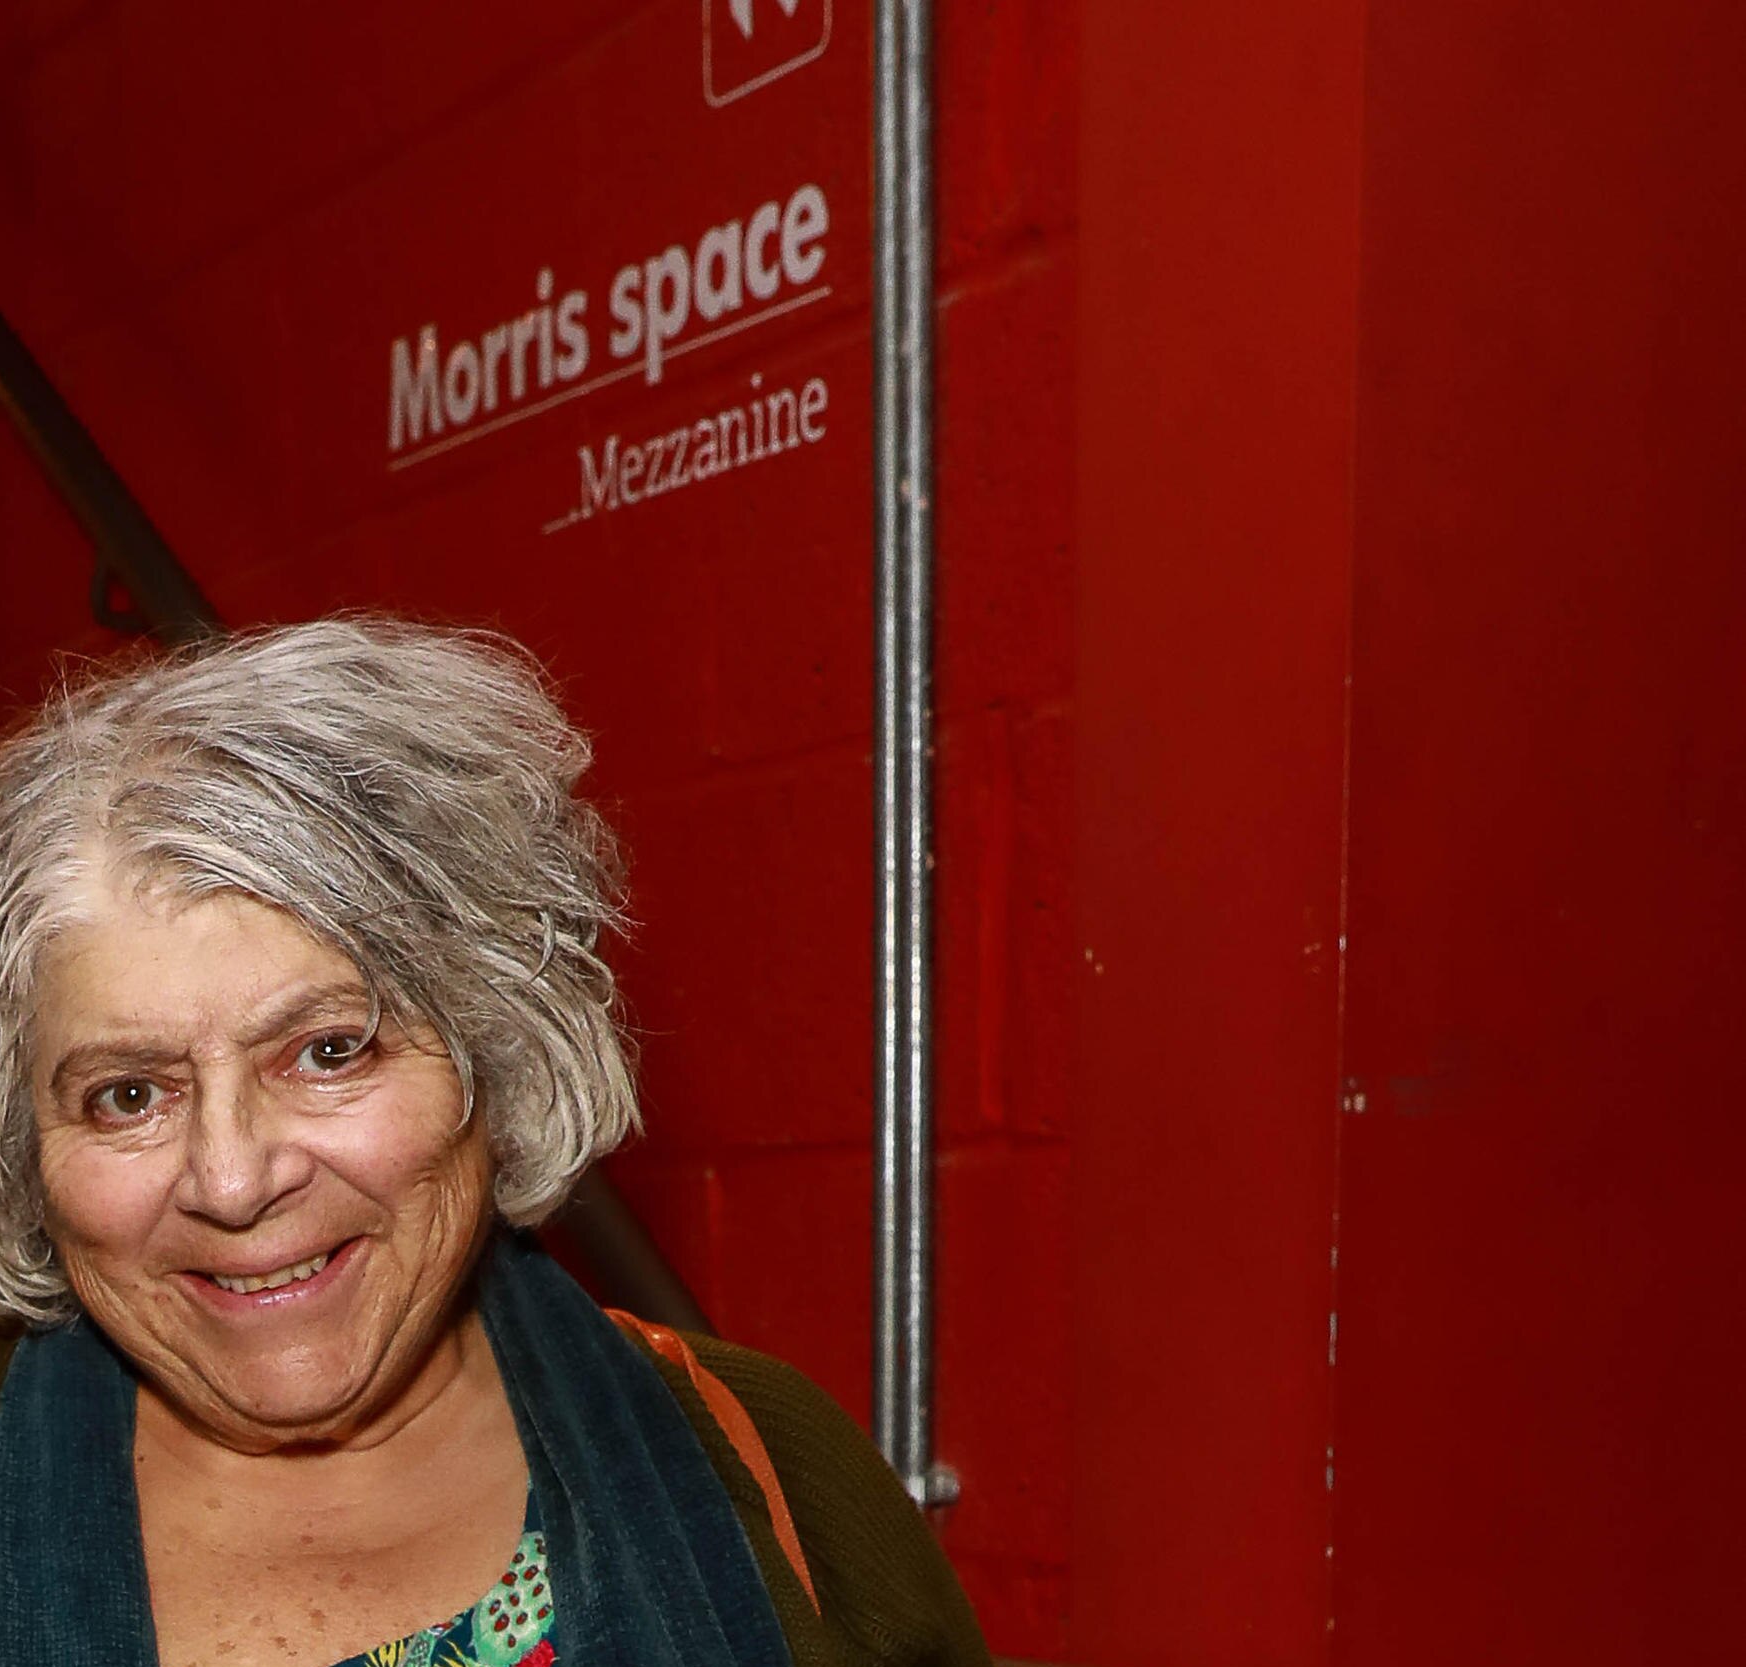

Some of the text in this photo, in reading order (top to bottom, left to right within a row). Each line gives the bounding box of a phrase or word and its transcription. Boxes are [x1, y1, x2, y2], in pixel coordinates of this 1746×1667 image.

[388, 184, 829, 452] Morris space
[574, 372, 829, 518] Mezzanine
